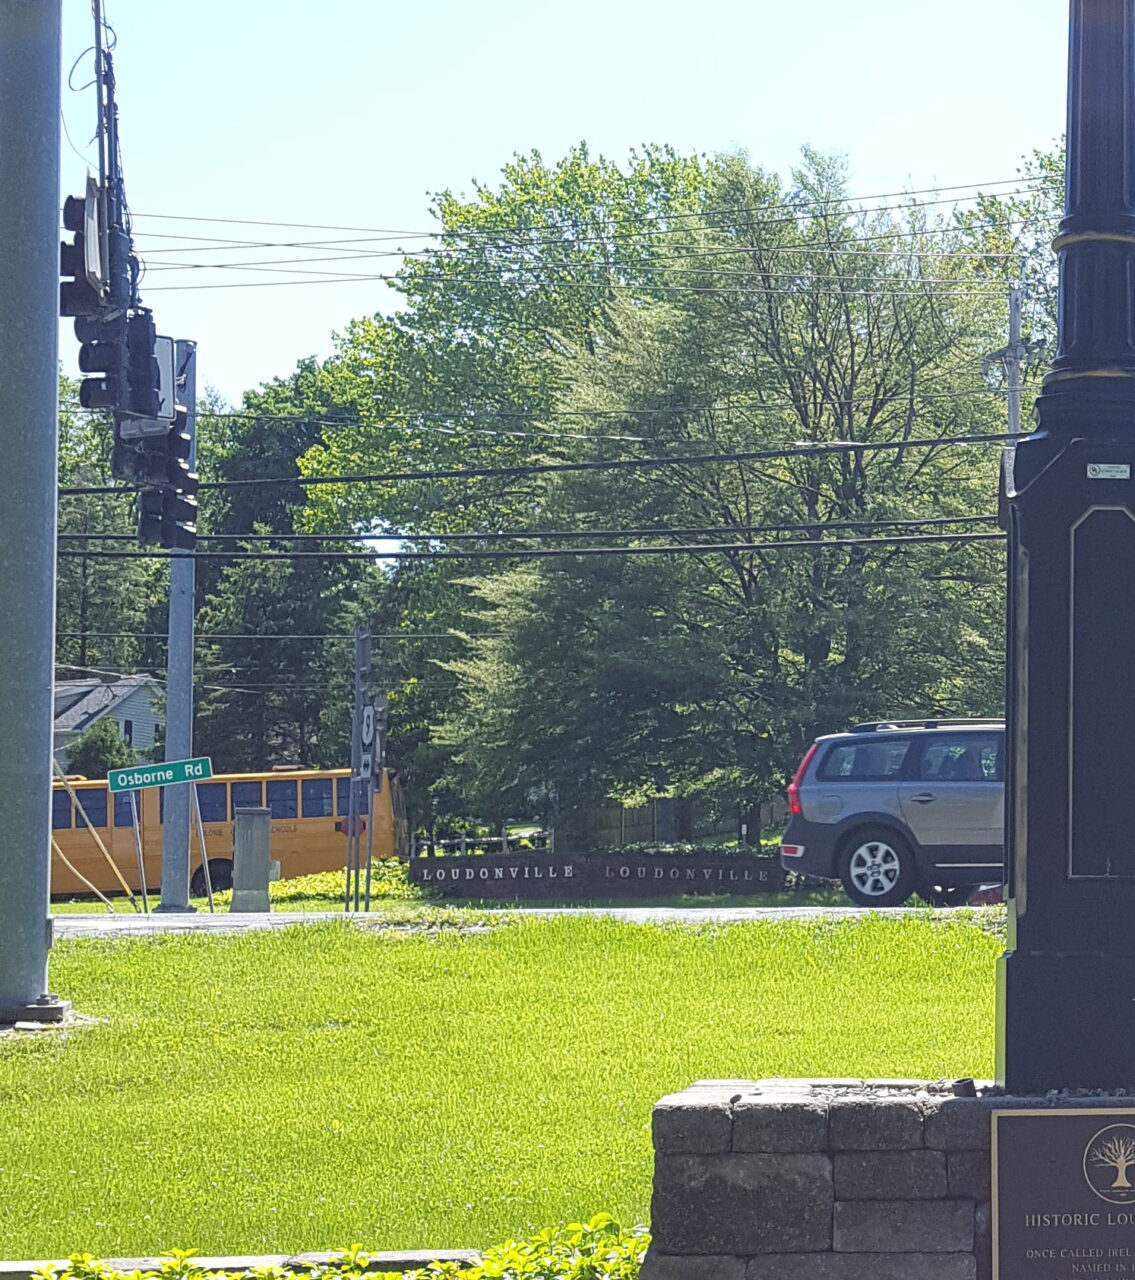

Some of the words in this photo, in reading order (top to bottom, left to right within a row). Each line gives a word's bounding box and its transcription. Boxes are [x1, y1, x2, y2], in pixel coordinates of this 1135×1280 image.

[117, 769, 174, 786] Osborne
[184, 763, 203, 777] Rd
[423, 865, 574, 881] LOUDONVILLE
[605, 866, 768, 882] LOUDONVILLE
[1025, 1213, 1100, 1227] HISTORIC
[1026, 1248, 1056, 1258] ONCE
[1060, 1247, 1104, 1258] CALLED
[1072, 1263, 1111, 1272] NAMED
[1115, 1263, 1127, 1272] IN
